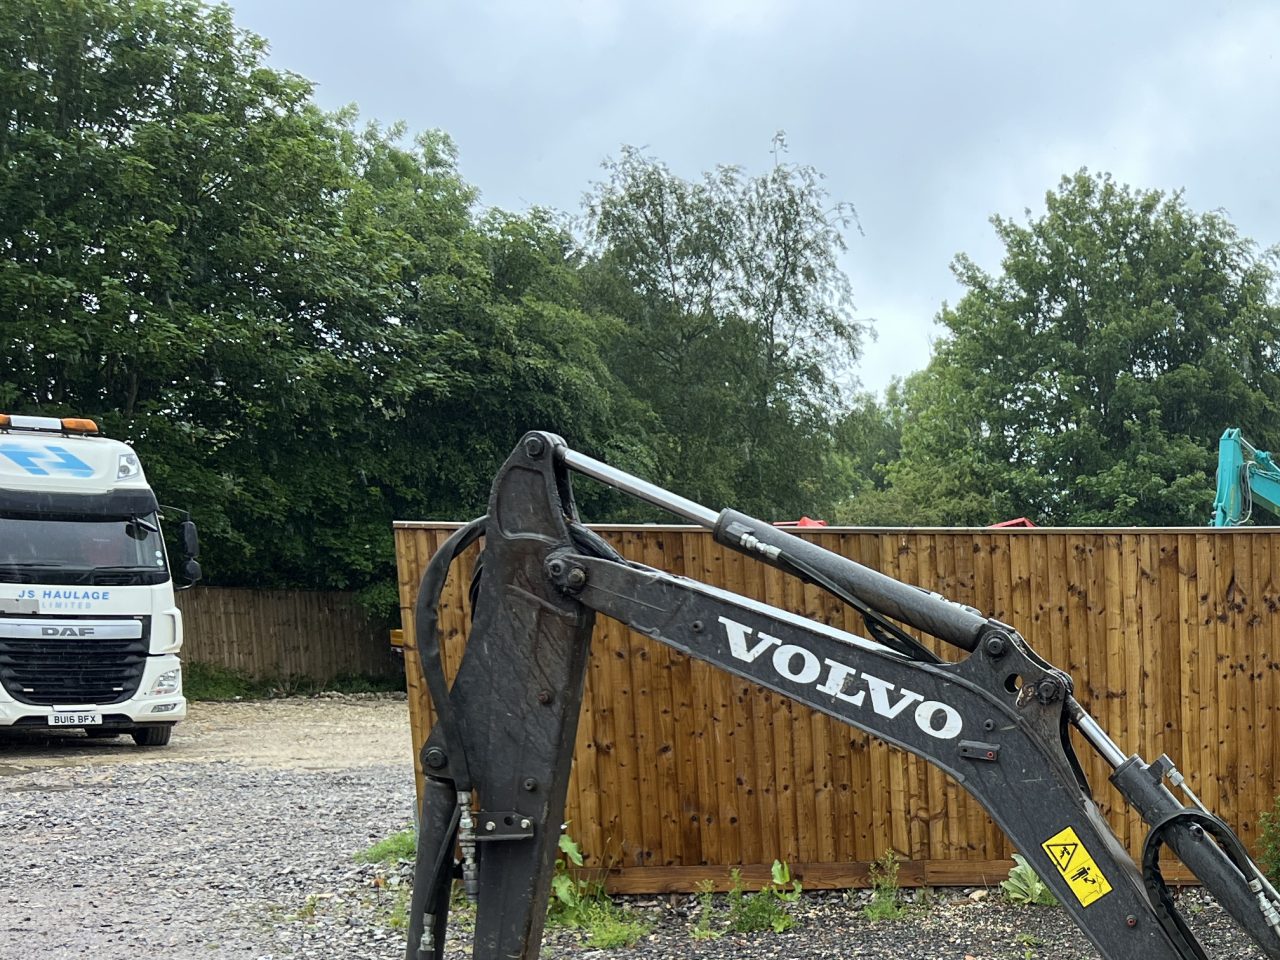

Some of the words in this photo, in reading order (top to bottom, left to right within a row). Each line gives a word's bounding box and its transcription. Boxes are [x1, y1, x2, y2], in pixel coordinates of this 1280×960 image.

[18, 590, 35, 598] JS
[43, 590, 110, 600] HAULAGE
[41, 627, 95, 636] DAF
[718, 615, 963, 739] VOLVO
[54, 715, 75, 723] BU16
[78, 715, 96, 723] BFX
